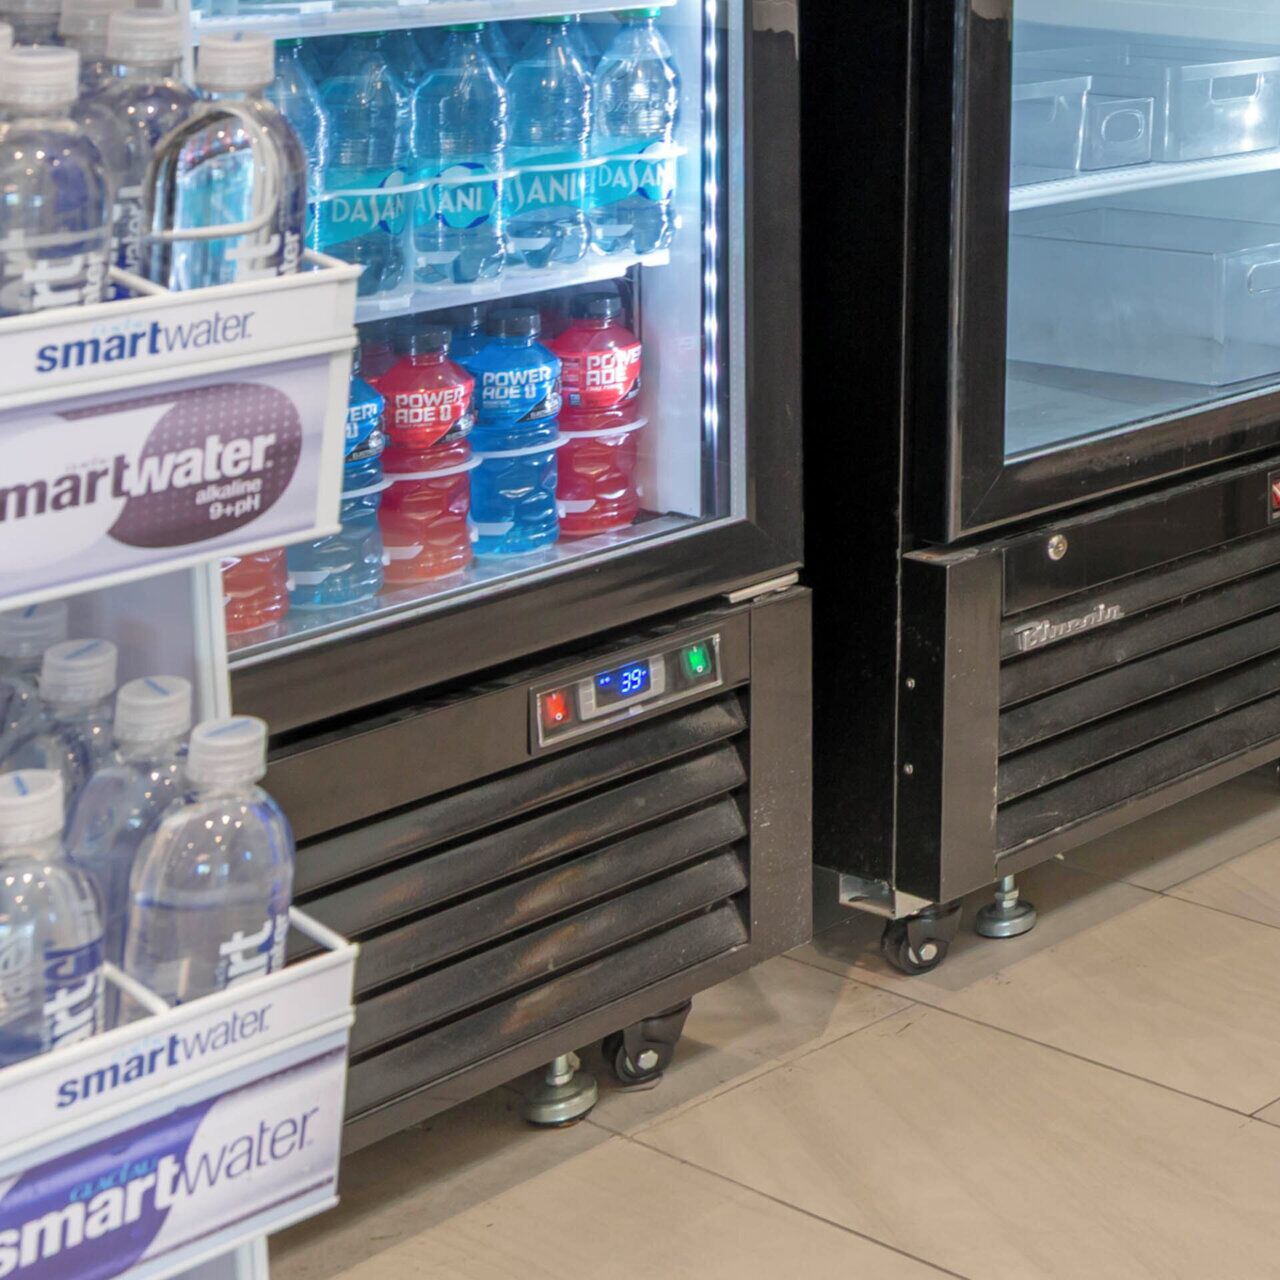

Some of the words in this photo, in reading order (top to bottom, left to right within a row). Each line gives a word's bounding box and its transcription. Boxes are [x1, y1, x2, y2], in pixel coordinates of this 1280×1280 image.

[598, 161, 668, 194] DASAN
[36, 311, 255, 374] smartwater
[483, 367, 552, 387] POWER
[585, 363, 627, 386] ADE
[395, 384, 464, 408] POWER
[0, 431, 278, 521] martwater
[196, 478, 263, 505] alkaline
[209, 496, 260, 521] 9+pH
[56, 1004, 272, 1108] smartwater
